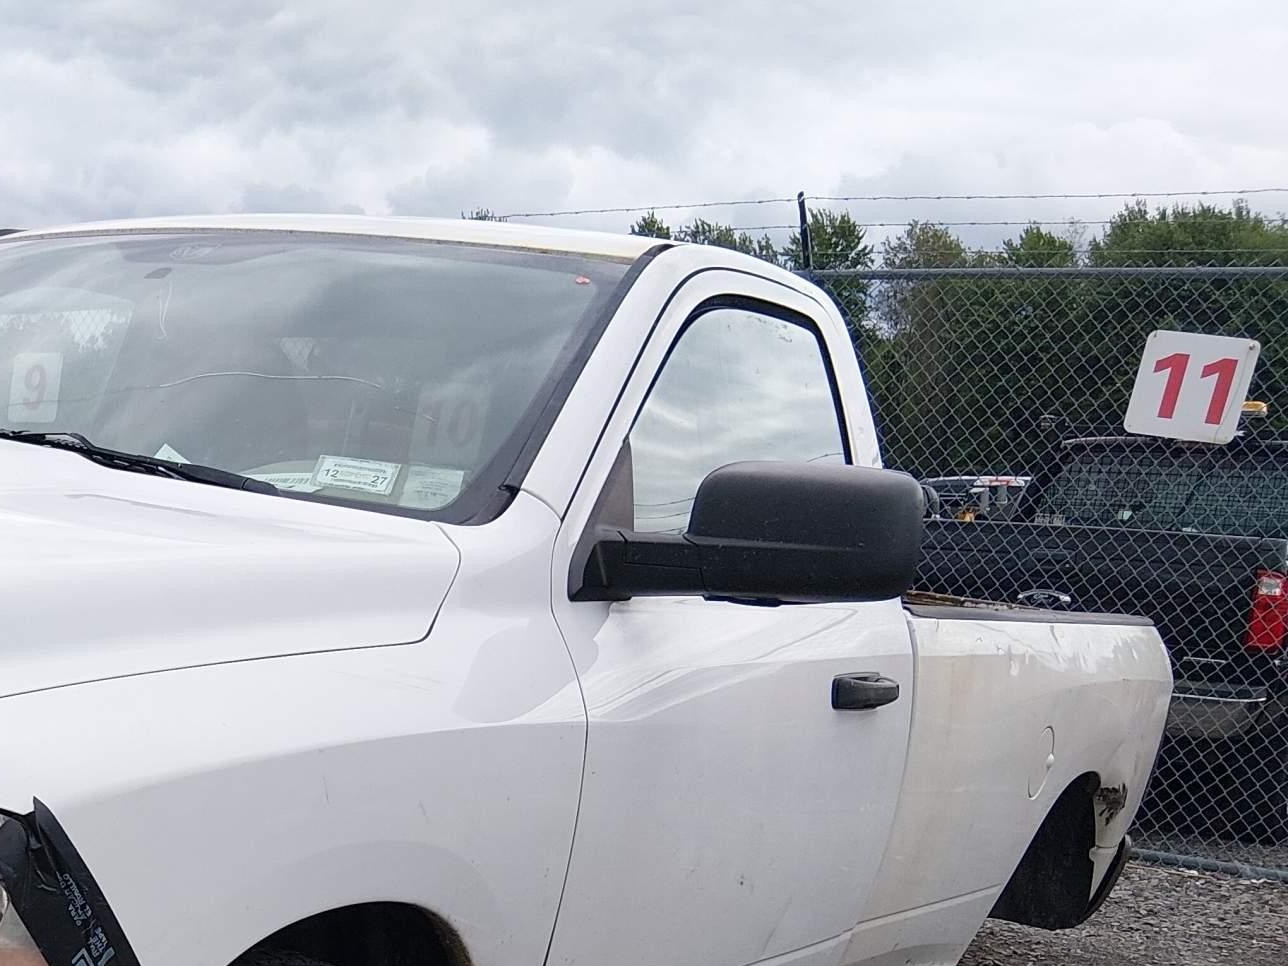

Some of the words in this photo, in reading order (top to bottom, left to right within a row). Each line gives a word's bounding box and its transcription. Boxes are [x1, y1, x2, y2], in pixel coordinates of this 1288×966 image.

[24, 364, 47, 411] 9
[1153, 352, 1239, 426] 11
[421, 399, 476, 447] 10
[323, 469, 340, 478] 12
[371, 475, 389, 485] 27
